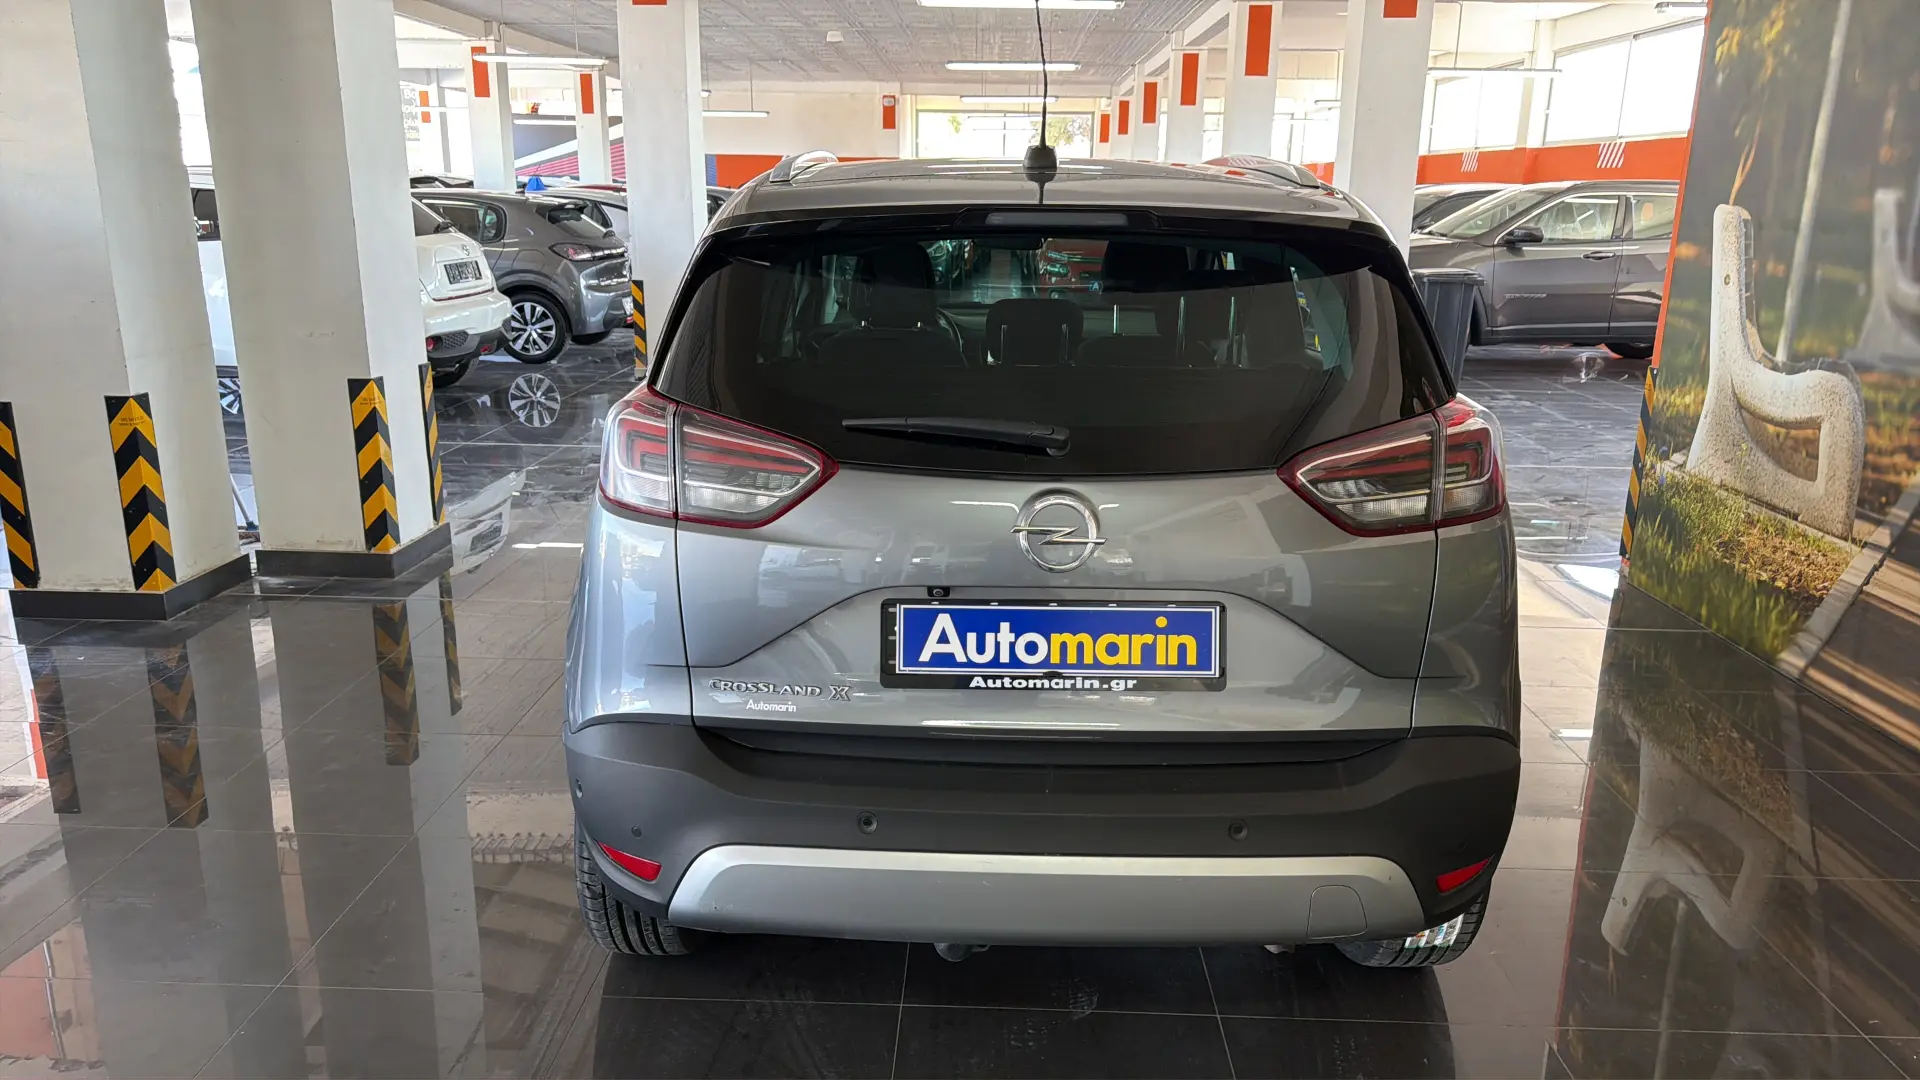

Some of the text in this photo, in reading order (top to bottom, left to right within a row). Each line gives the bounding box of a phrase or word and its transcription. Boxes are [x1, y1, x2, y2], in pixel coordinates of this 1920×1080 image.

[918, 612, 1197, 666] Automarin
[709, 679, 851, 702] CROSSLAND X
[969, 676, 1137, 691] Automarin.gr
[746, 699, 797, 713] Automarin
